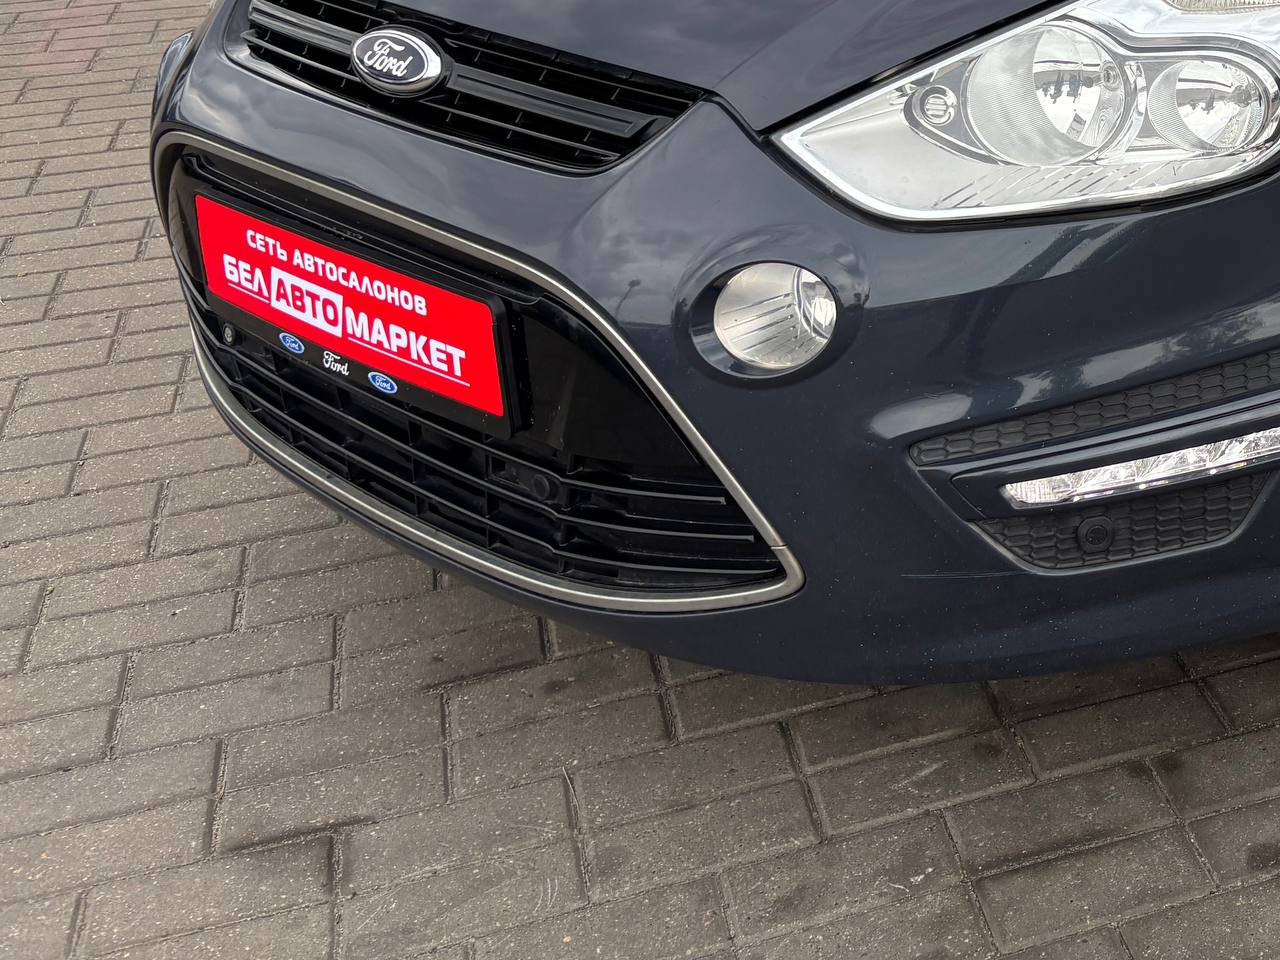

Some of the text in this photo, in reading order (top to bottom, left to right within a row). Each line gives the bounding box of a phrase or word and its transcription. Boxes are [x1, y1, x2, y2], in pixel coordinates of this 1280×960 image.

[363, 38, 414, 77] Ford
[246, 229, 428, 316] СЕТЬ АВТОСАЛОНОВ
[322, 350, 350, 376] Ford
